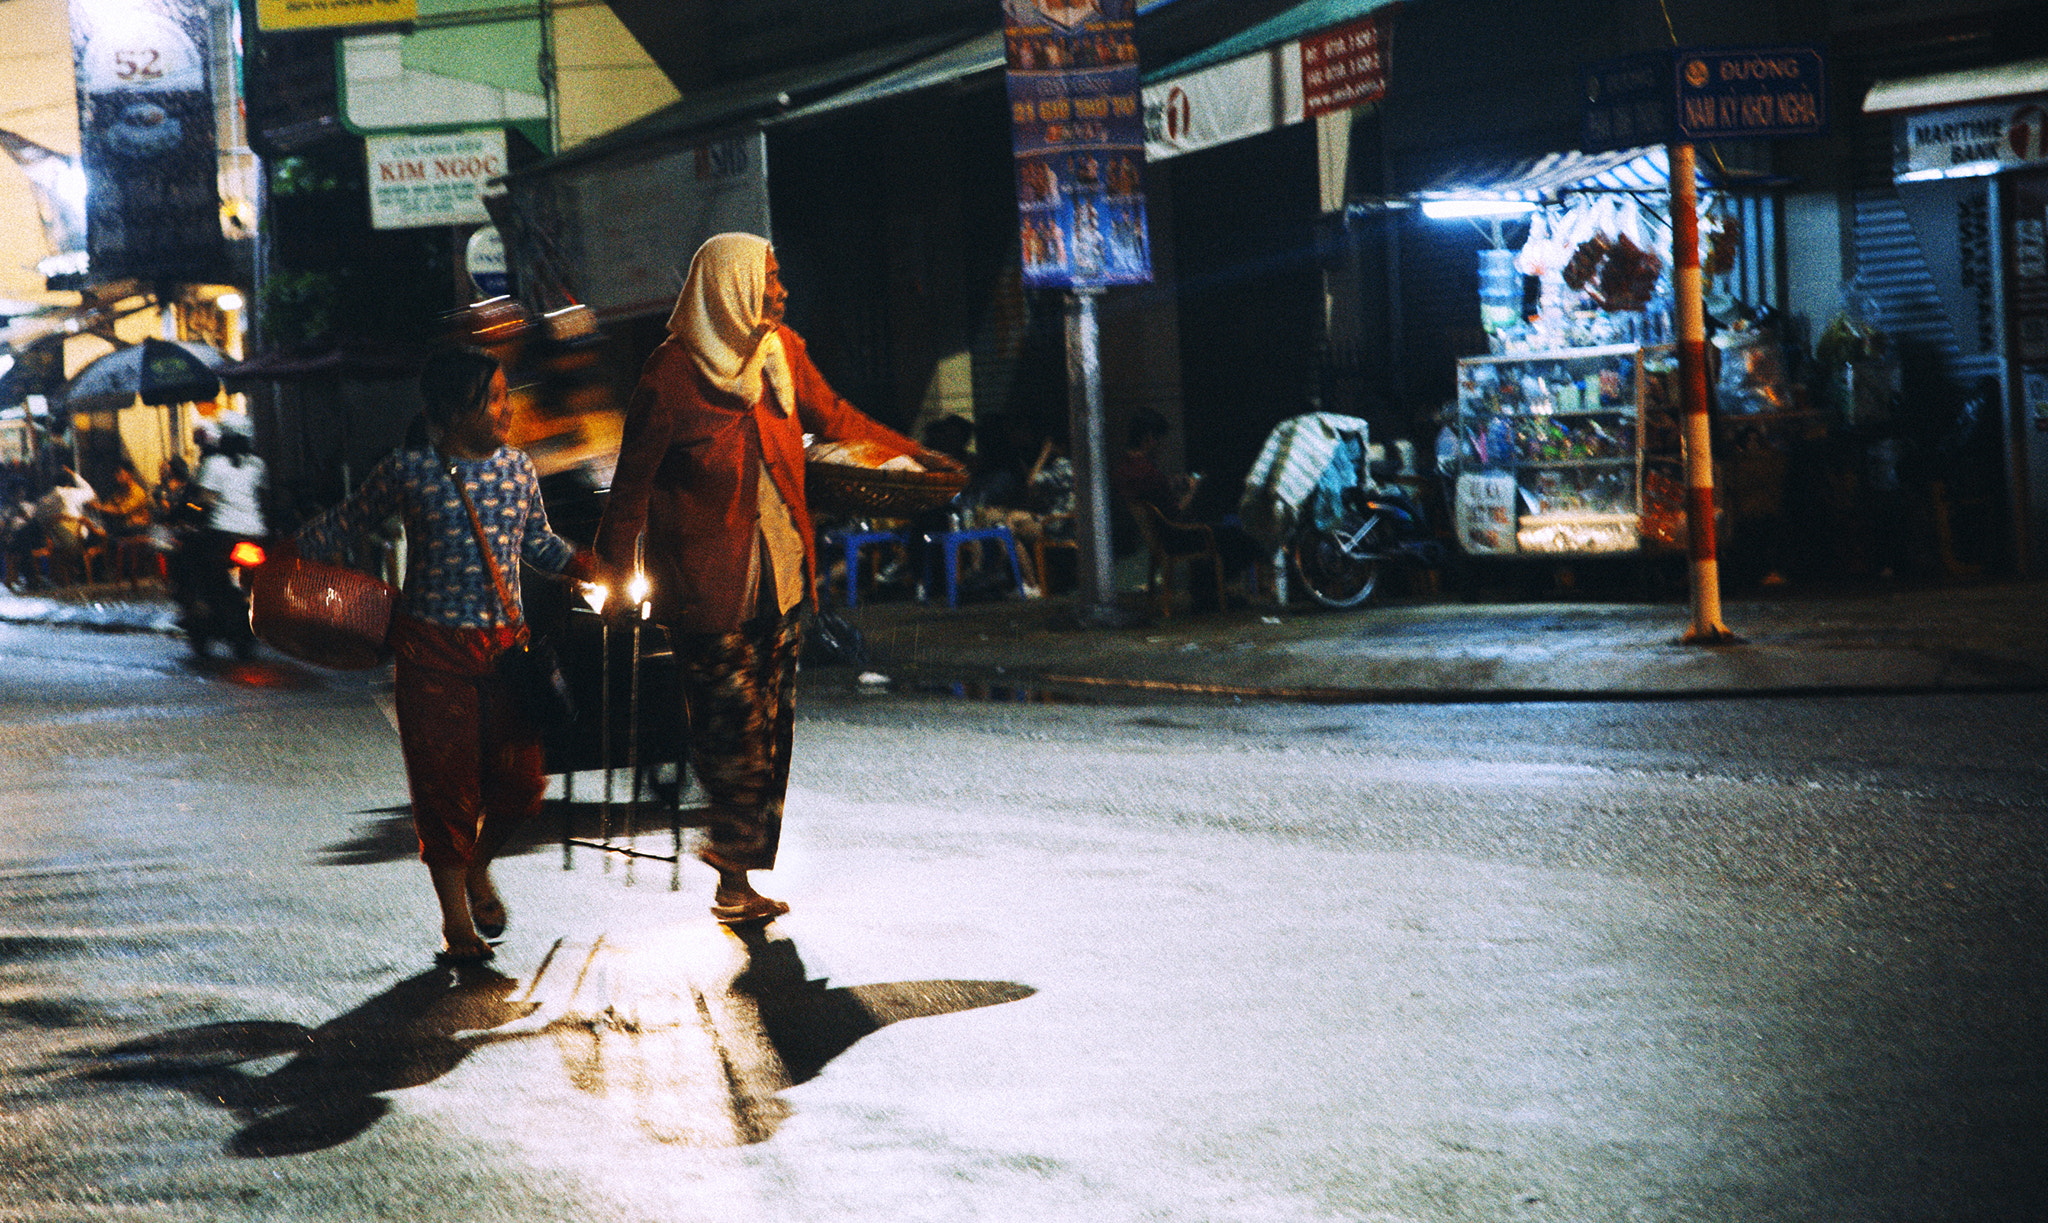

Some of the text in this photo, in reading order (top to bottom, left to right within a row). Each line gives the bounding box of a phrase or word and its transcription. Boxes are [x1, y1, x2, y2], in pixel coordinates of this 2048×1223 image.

[114, 48, 164, 81] 52
[1914, 121, 2004, 144] MARITIME
[1951, 143, 1999, 164] BANK
[379, 160, 425, 181] KIM
